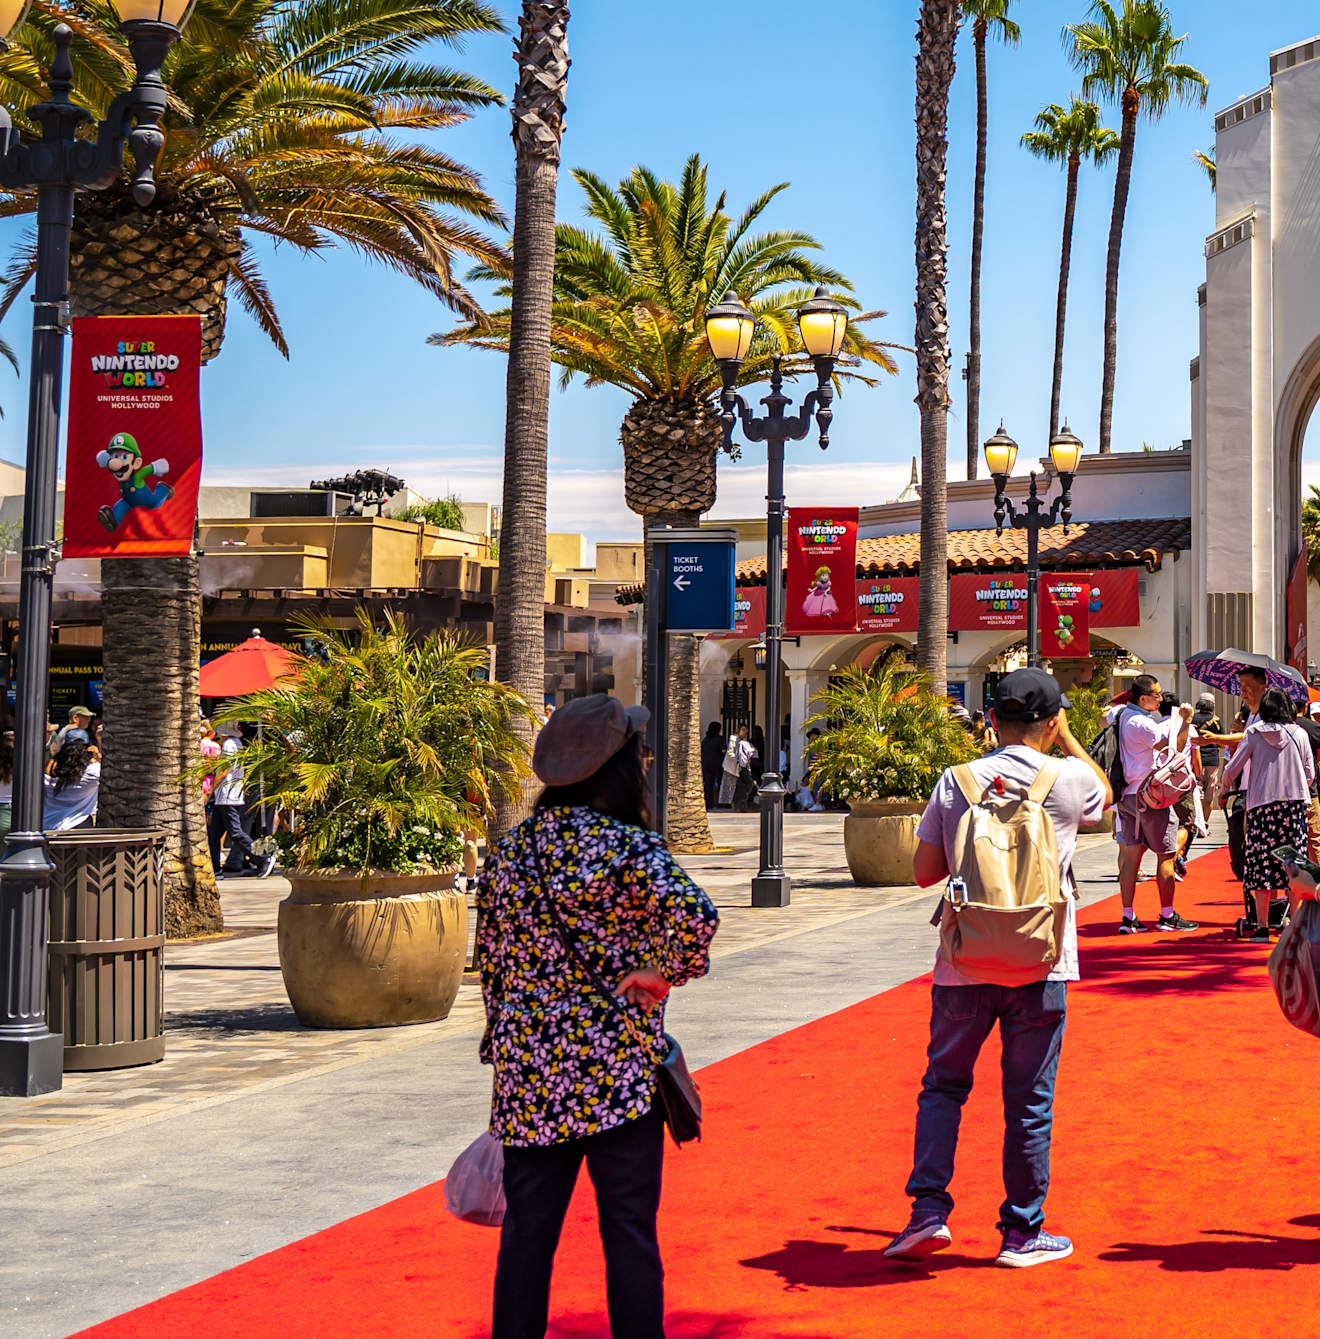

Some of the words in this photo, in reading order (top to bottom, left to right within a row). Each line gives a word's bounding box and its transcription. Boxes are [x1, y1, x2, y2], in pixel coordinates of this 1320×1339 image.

[117, 341, 155, 354] SUPER
[91, 354, 180, 372] NINTENDO
[104, 371, 166, 388] WORLD
[798, 526, 847, 536] NINTENDO
[805, 534, 838, 543] ORLD
[673, 556, 699, 564] TICKET
[673, 565, 704, 573] BOOTHS
[858, 592, 905, 605] NINTENDO
[975, 588, 1028, 601] NINTENDO
[734, 601, 752, 611] ENDO
[867, 604, 897, 614] ORLD
[986, 599, 1019, 611] ORLD
[208, 642, 237, 651] ANNU
[48, 666, 73, 674] NNUAL
[74, 666, 92, 674] PASS
